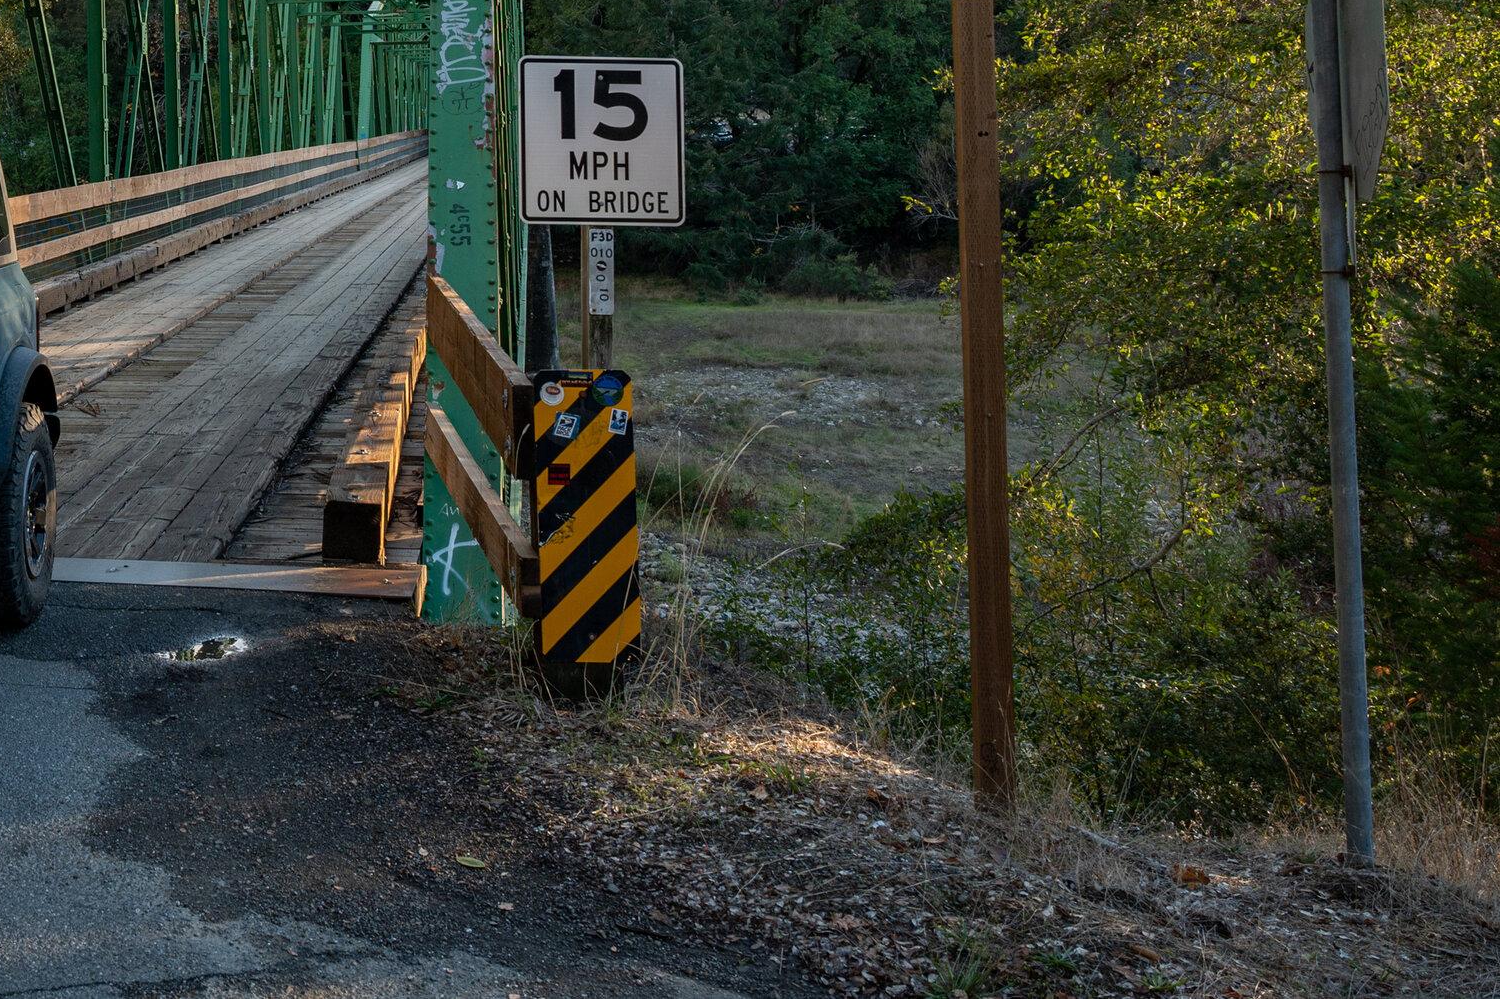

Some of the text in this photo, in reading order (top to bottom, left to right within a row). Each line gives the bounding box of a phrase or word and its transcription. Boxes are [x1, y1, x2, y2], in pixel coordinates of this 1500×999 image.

[553, 69, 649, 142] 15
[569, 151, 630, 181] MPH
[537, 190, 669, 214] ON BRIDGE
[591, 232, 613, 242] F3D
[590, 247, 613, 258] 010
